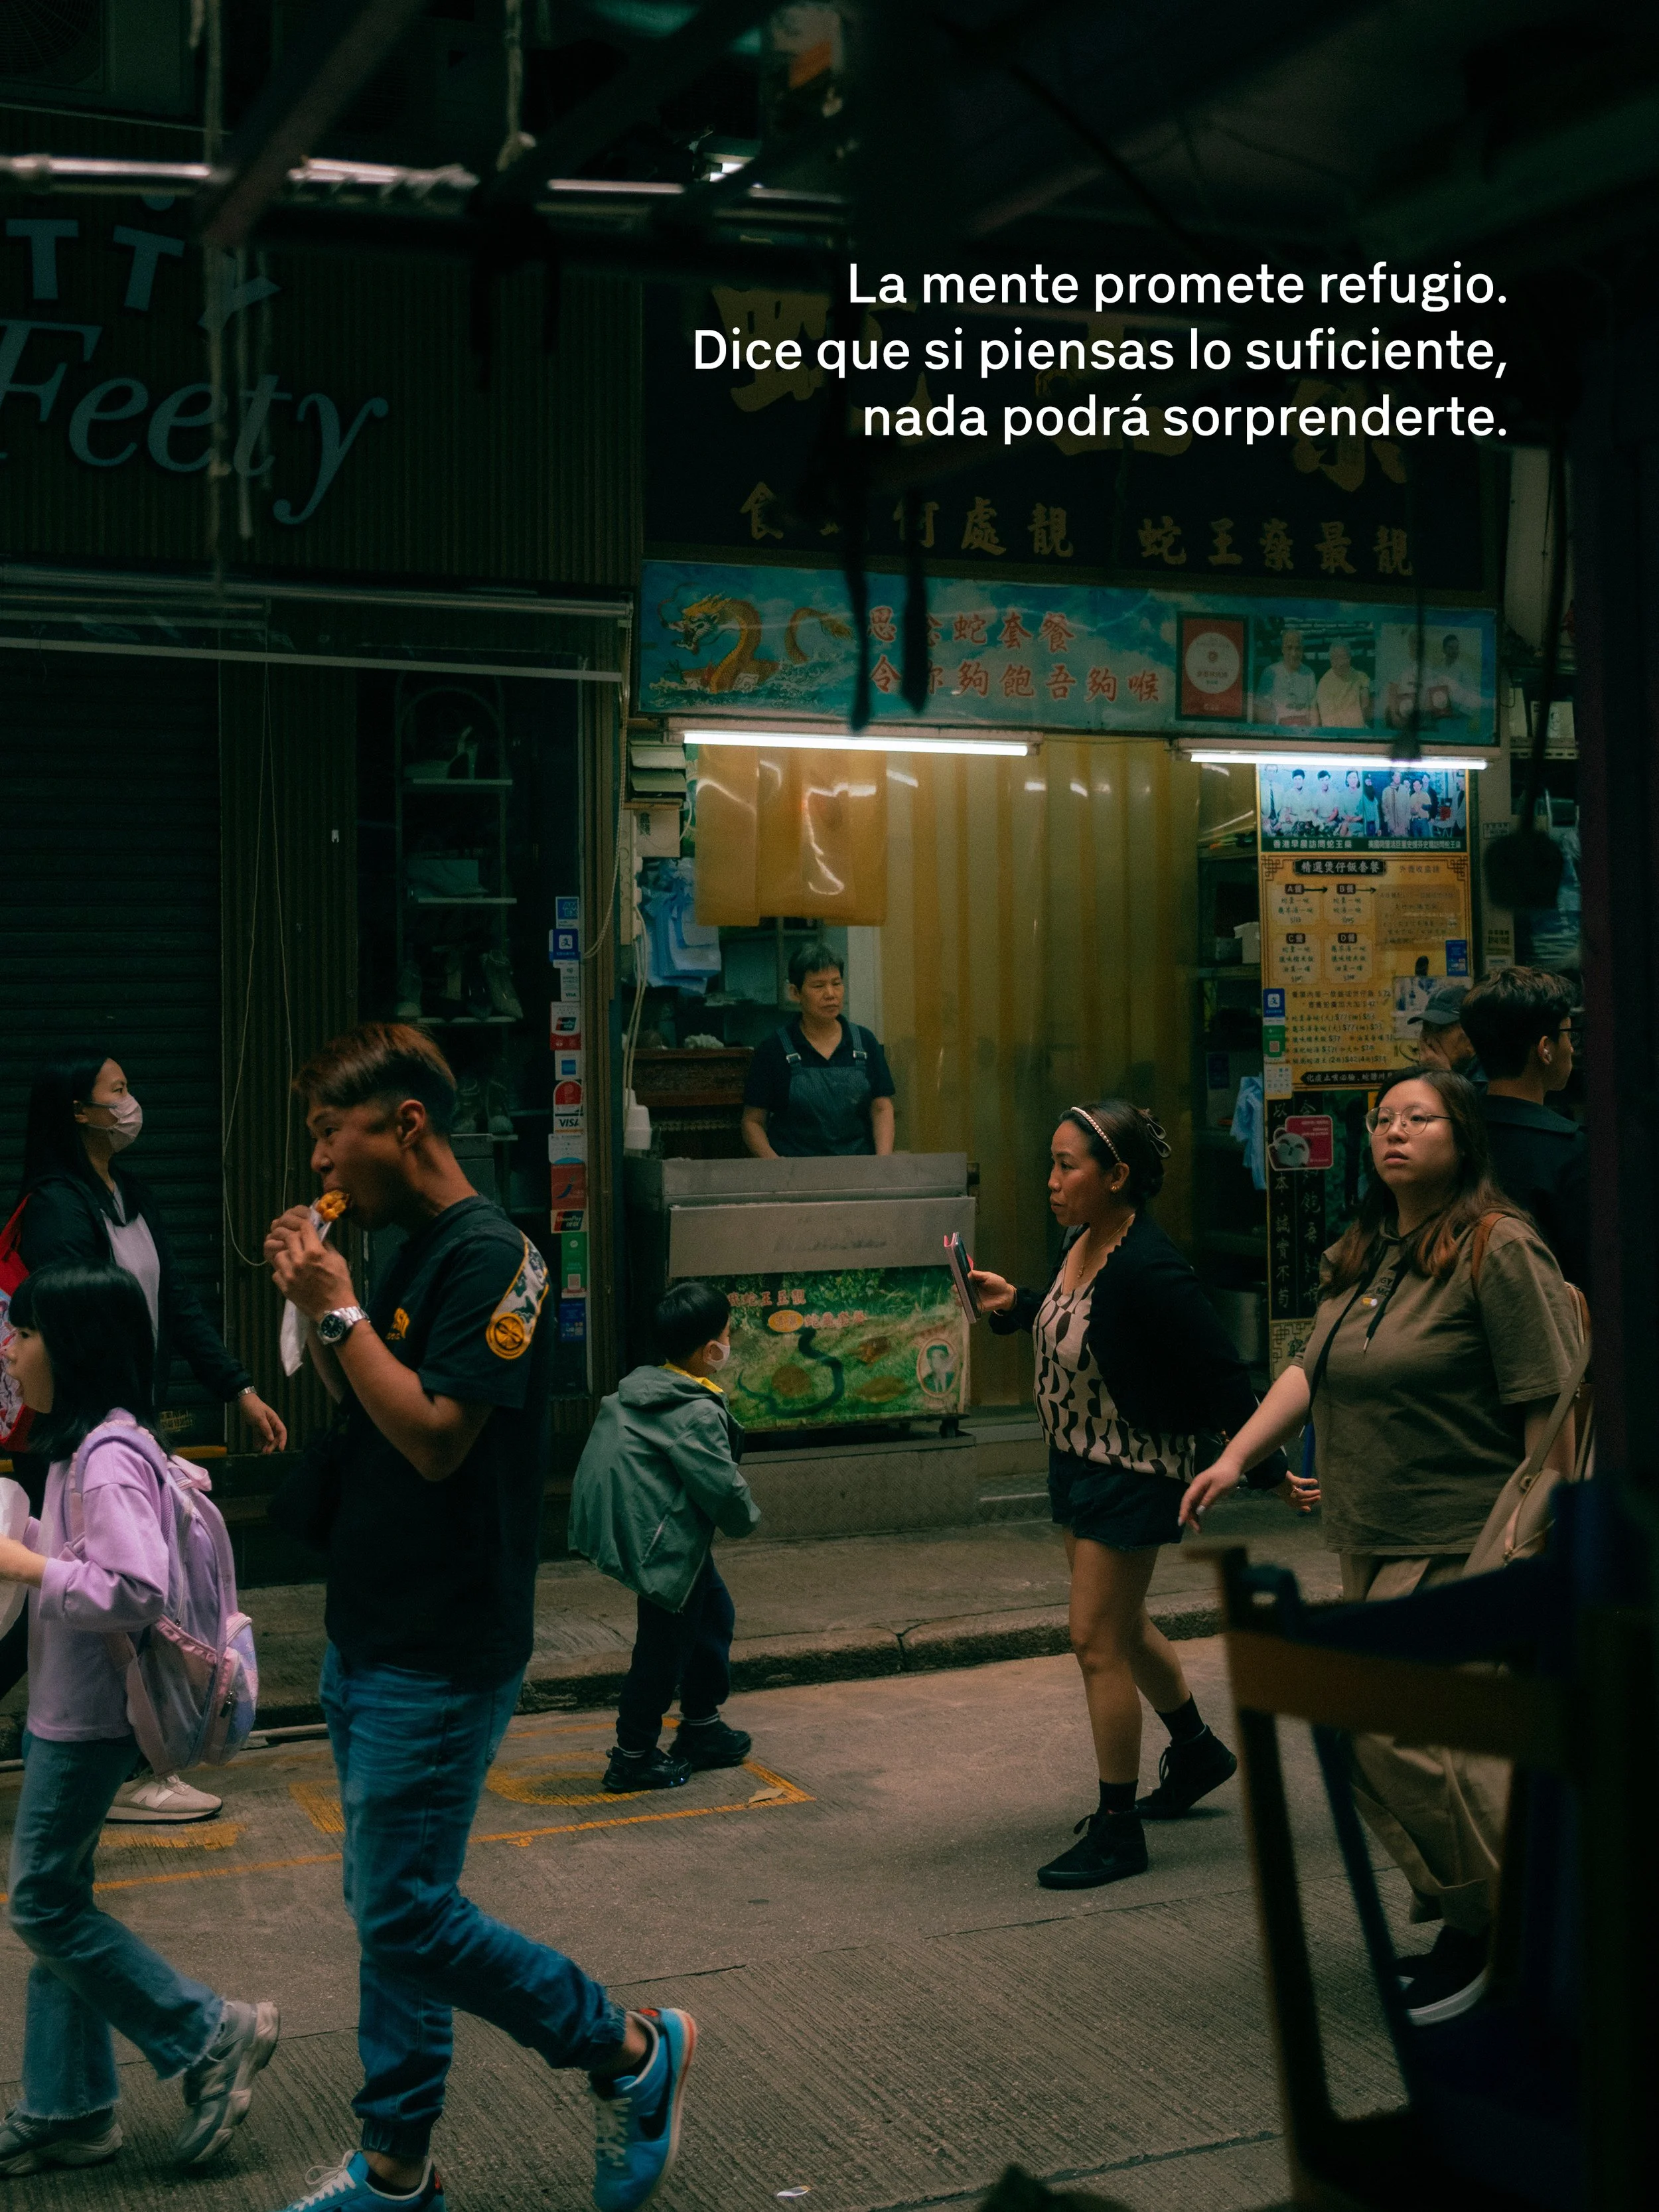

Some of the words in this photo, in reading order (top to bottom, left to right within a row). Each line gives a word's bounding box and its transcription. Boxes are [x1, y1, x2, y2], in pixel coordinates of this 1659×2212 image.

[0, 320, 390, 526] Feety
[739, 480, 1074, 557] 食何處靚
[1301, 861, 1380, 873] 精選煲仔飯套餐
